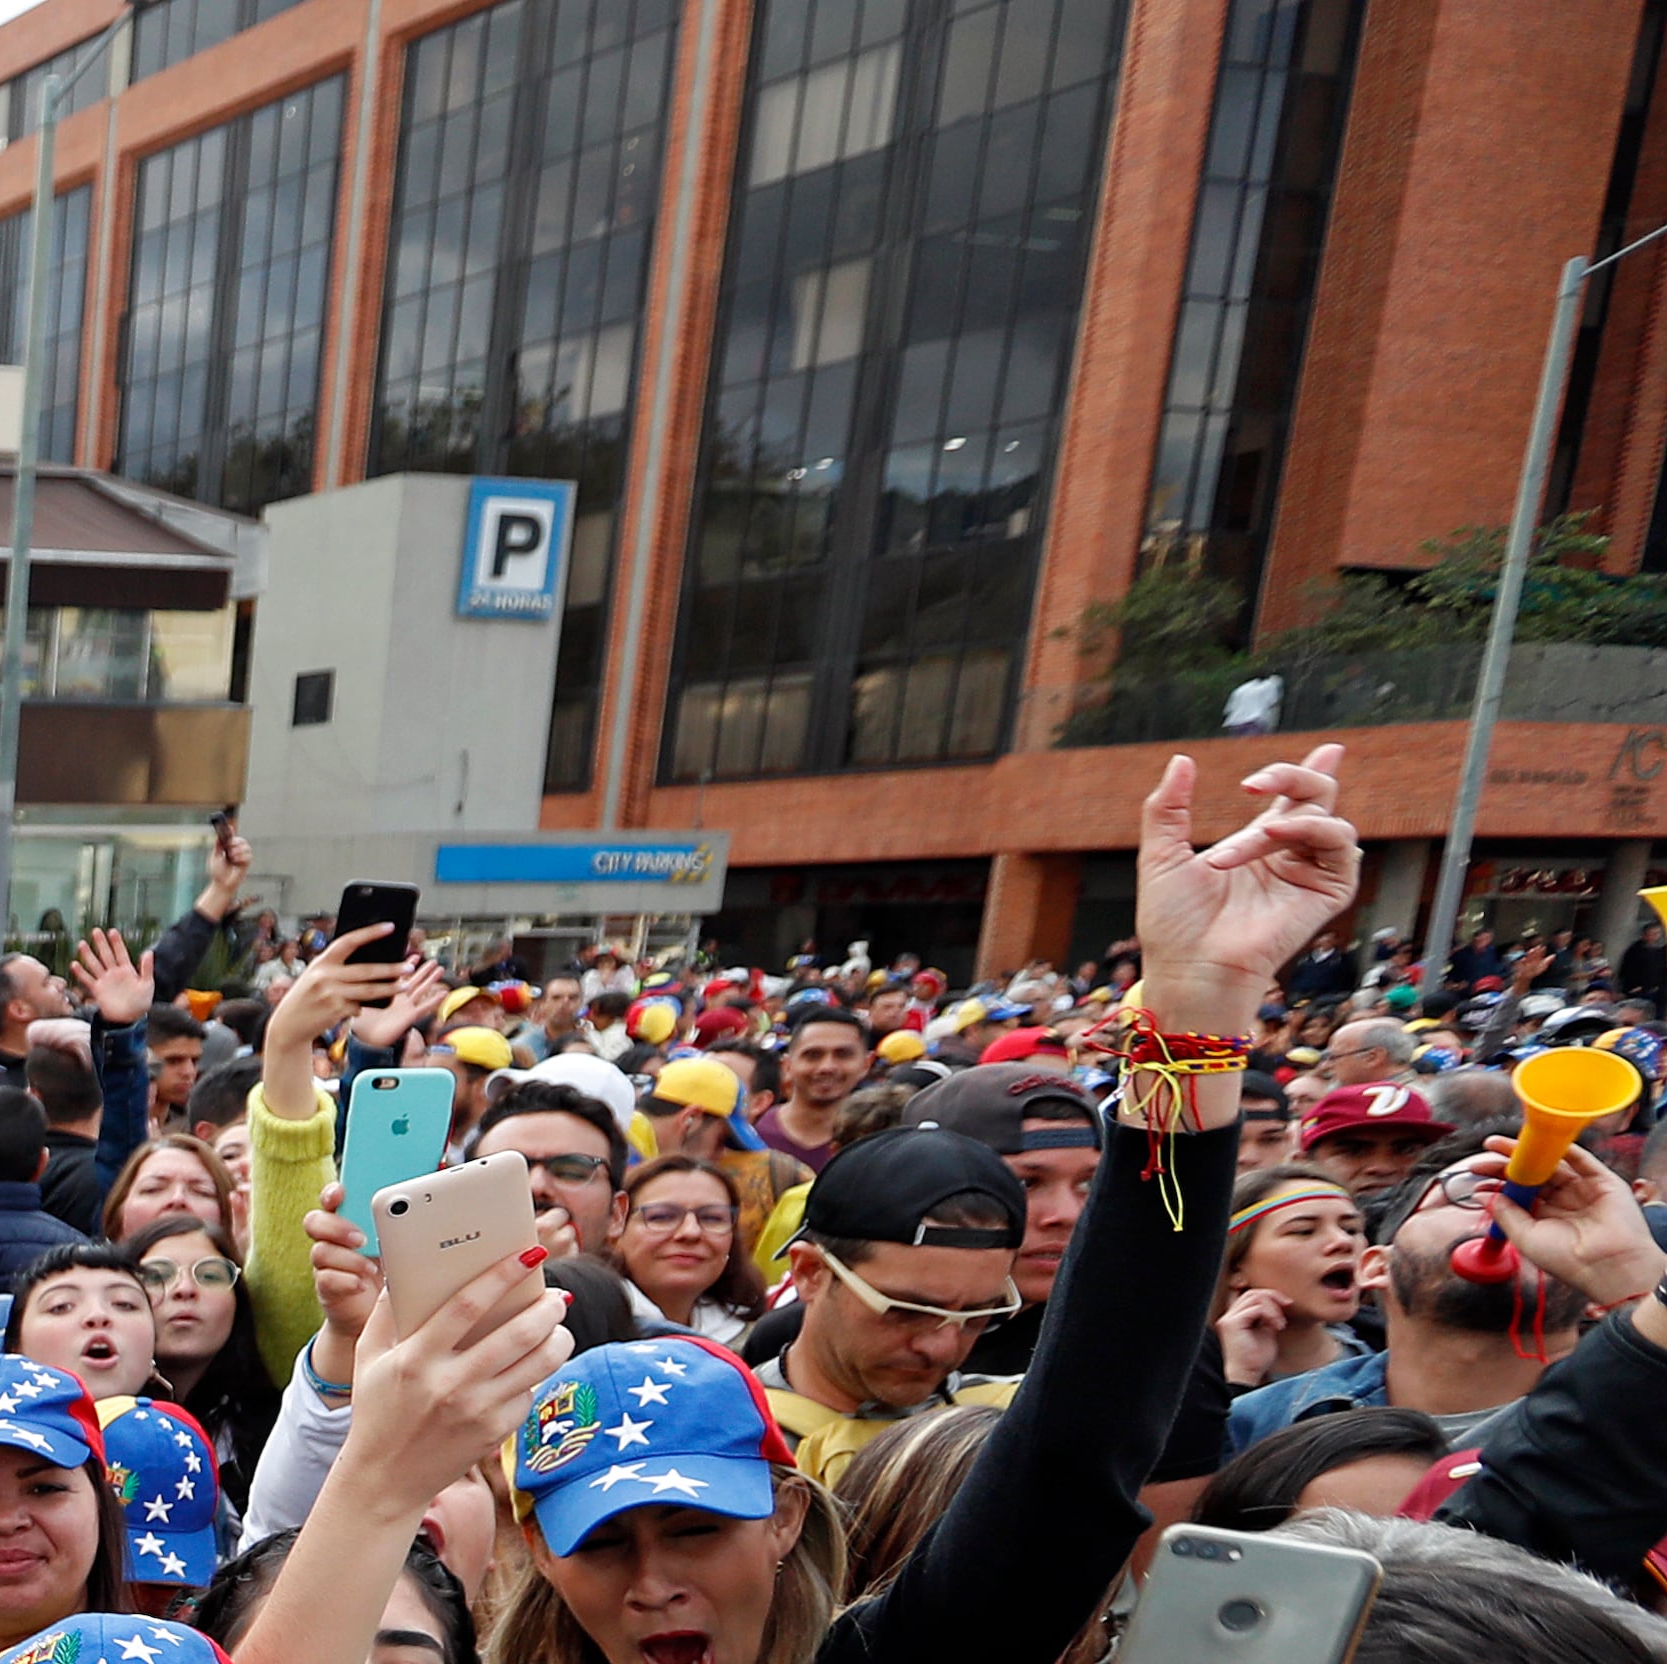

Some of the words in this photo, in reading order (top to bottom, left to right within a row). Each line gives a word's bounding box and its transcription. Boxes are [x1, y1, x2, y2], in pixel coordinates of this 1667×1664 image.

[490, 513, 543, 579] P
[593, 850, 632, 873] CITY
[634, 848, 705, 873] PARKING
[439, 1230, 481, 1249] BLU
